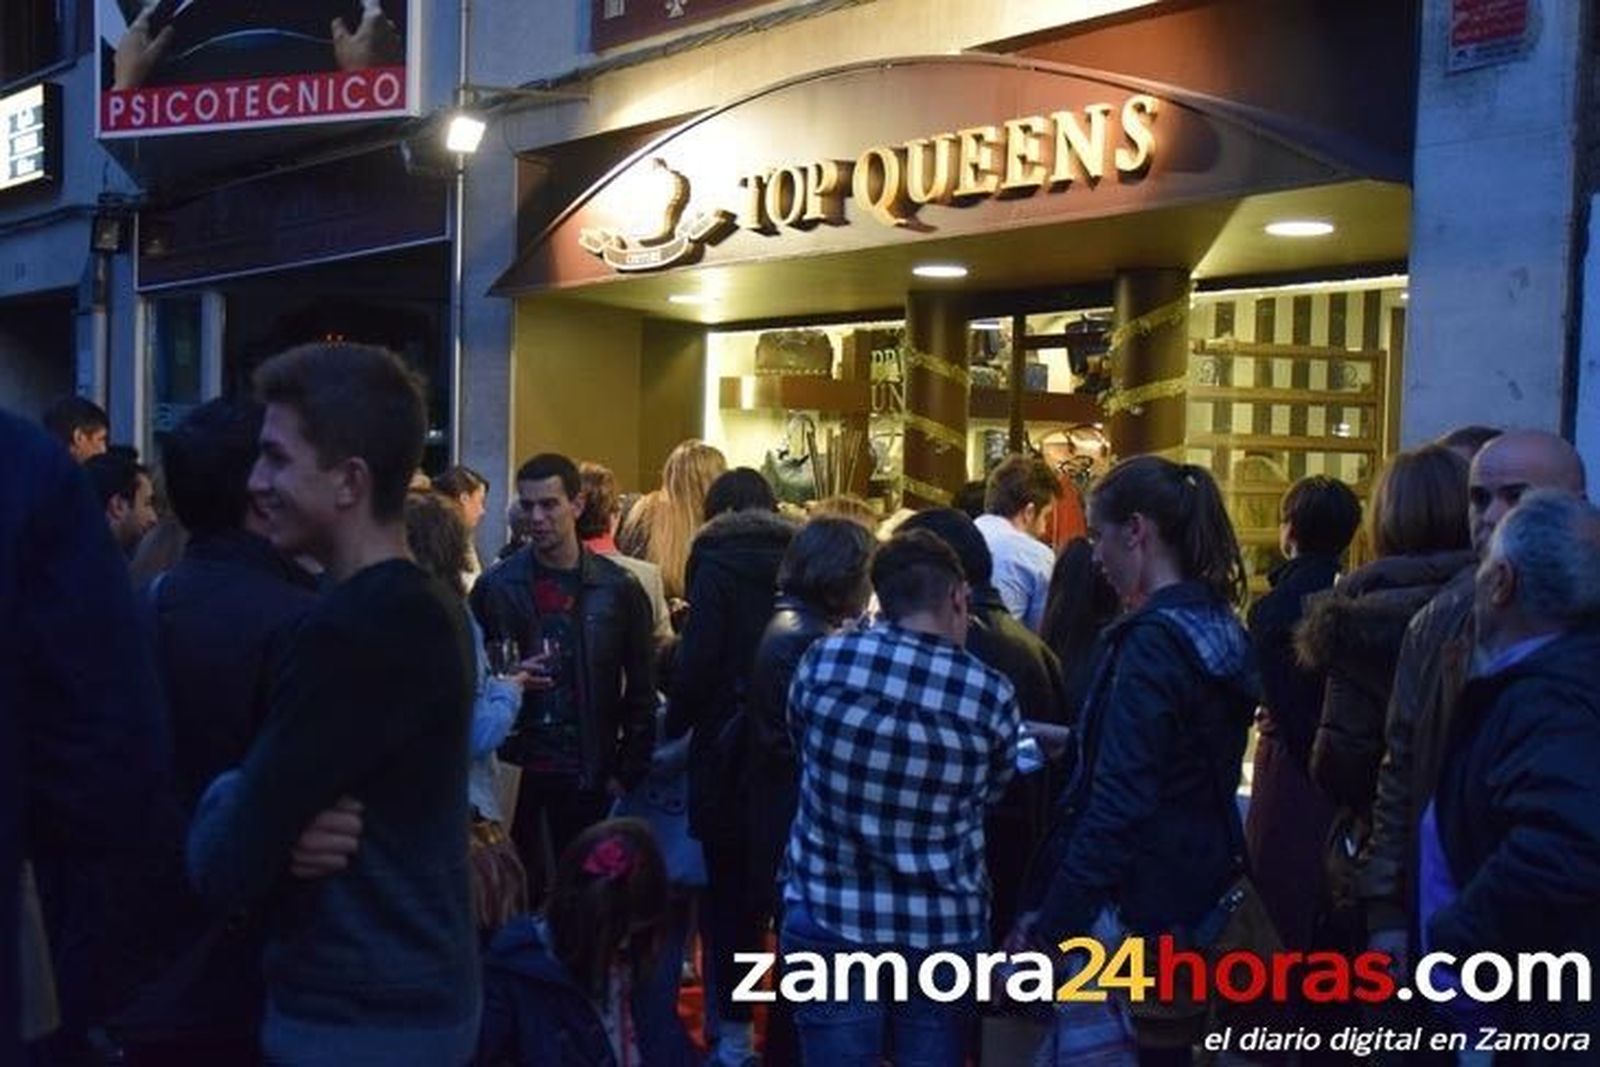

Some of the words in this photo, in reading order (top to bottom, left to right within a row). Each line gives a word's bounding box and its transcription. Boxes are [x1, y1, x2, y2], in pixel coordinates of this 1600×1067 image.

[108, 73, 400, 127] PSICOTECNICO
[739, 164, 840, 233] TOP
[853, 95, 1158, 227] QUEENS
